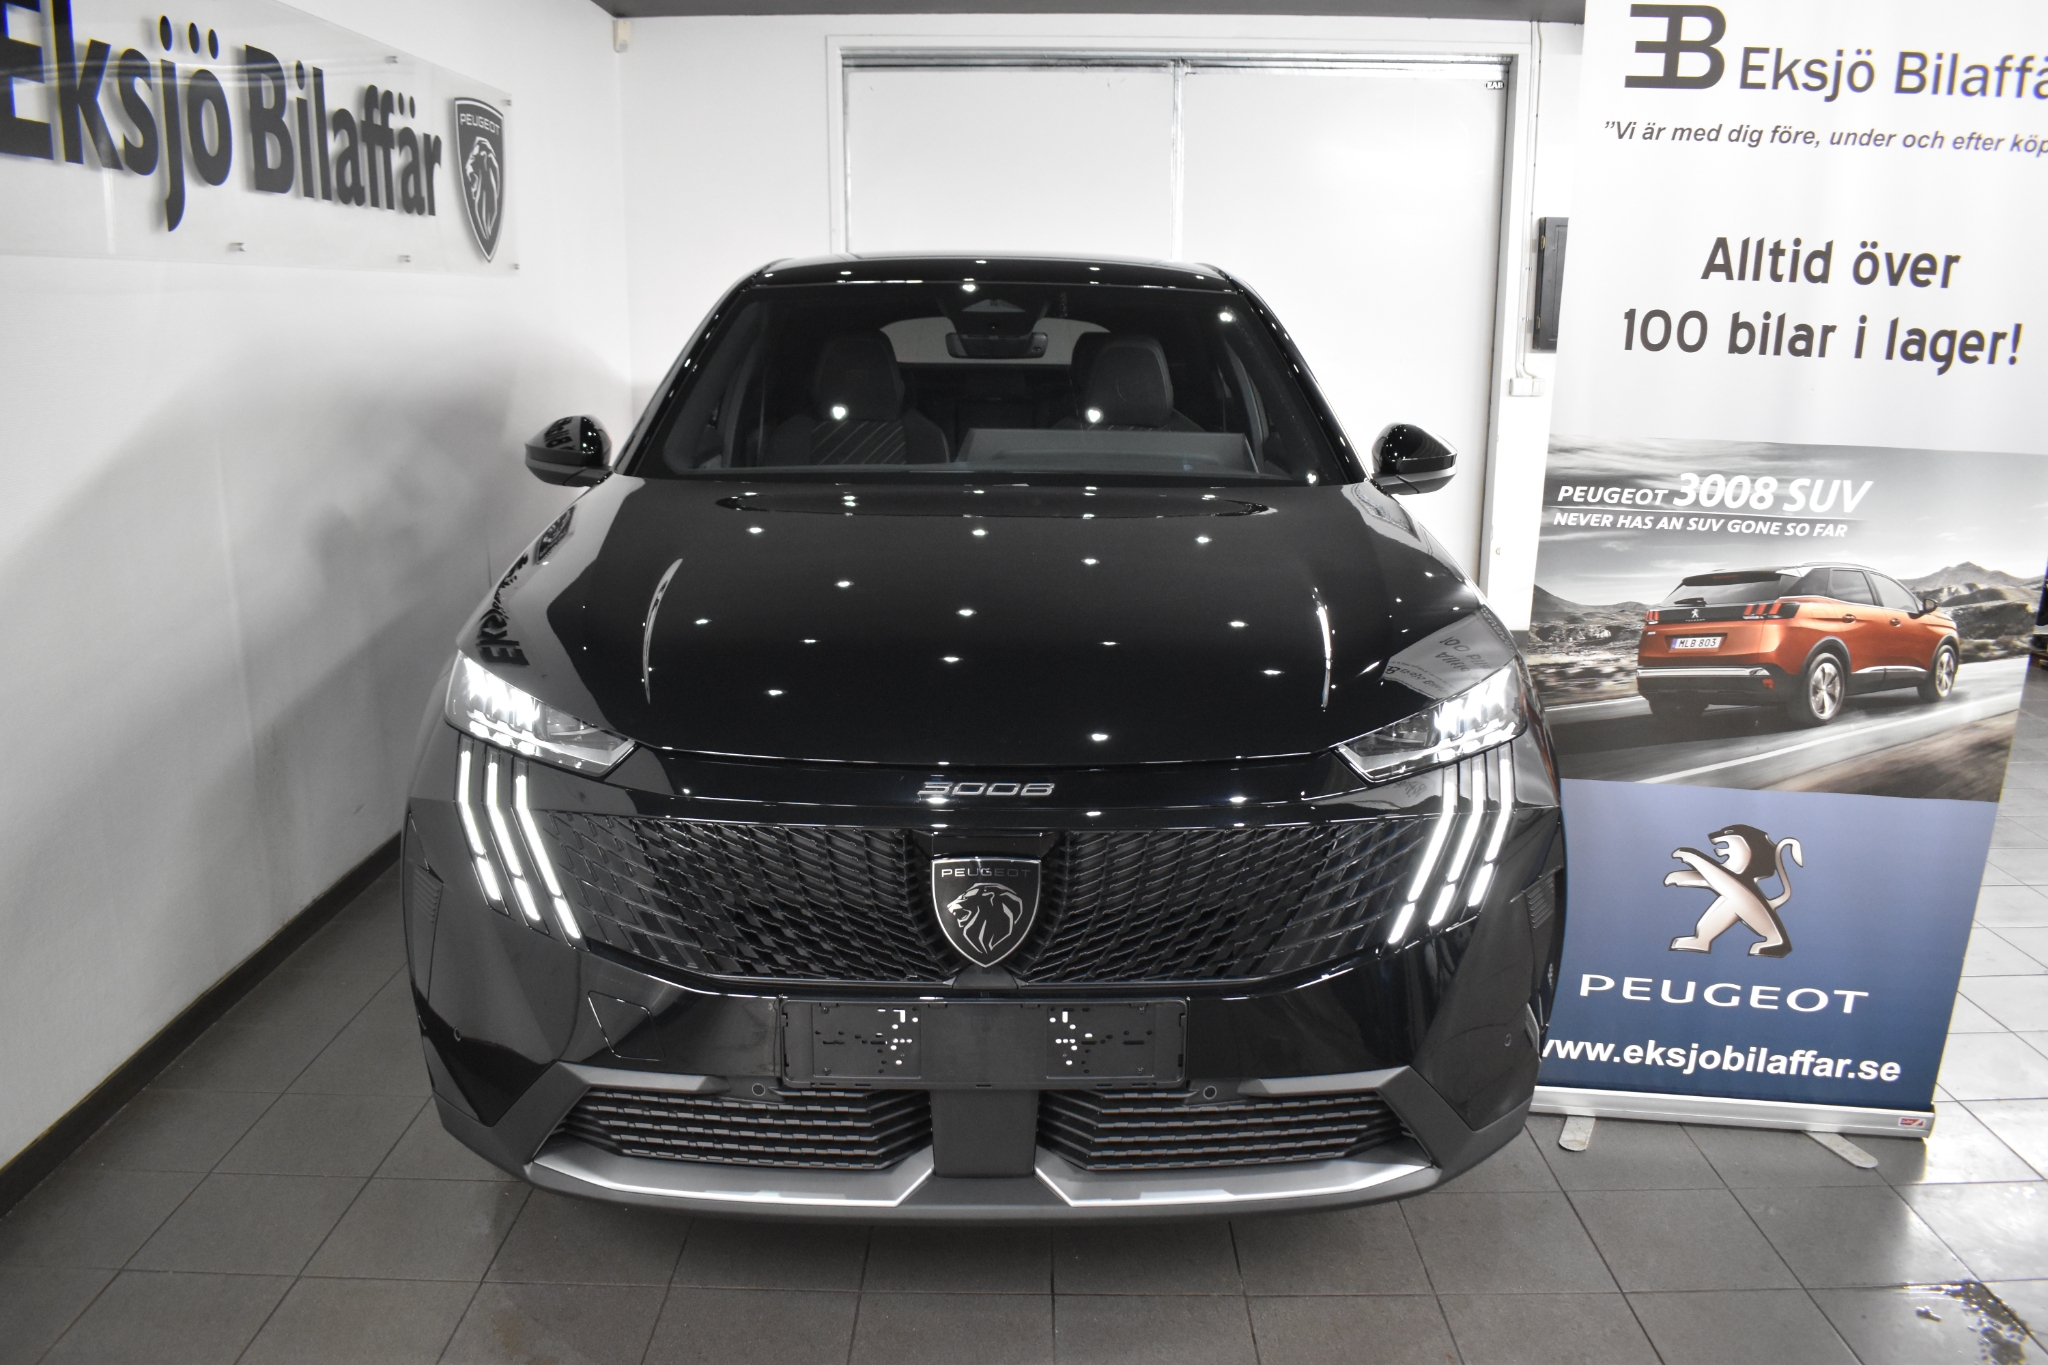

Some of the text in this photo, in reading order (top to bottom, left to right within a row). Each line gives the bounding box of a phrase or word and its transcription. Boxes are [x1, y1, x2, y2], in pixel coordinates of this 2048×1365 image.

[1739, 46, 1876, 103] Eksjö
[0, 0, 442, 232] Eksjö Bilaffär
[459, 112, 501, 136] PEUGEOT
[1641, 122, 1667, 141] är
[1671, 123, 1723, 142] med
[1727, 124, 1764, 148] dig
[1769, 125, 1820, 148] före,
[1829, 128, 1897, 147] under
[1902, 130, 1945, 149] och
[1952, 132, 2005, 152] efter
[2009, 133, 2048, 158] köp
[1701, 236, 1961, 289] Alltid över
[1623, 308, 2023, 376] 100 bilar i lager!
[1557, 472, 1874, 514] PEUGEOT 3008 SUV
[1553, 512, 1849, 538] NEVER HAS AN SUV GONE SO FAR
[1678, 638, 1717, 648] MLB 803
[941, 867, 1032, 878] PEUGEOT
[1579, 973, 1869, 1014] PEUGEOT
